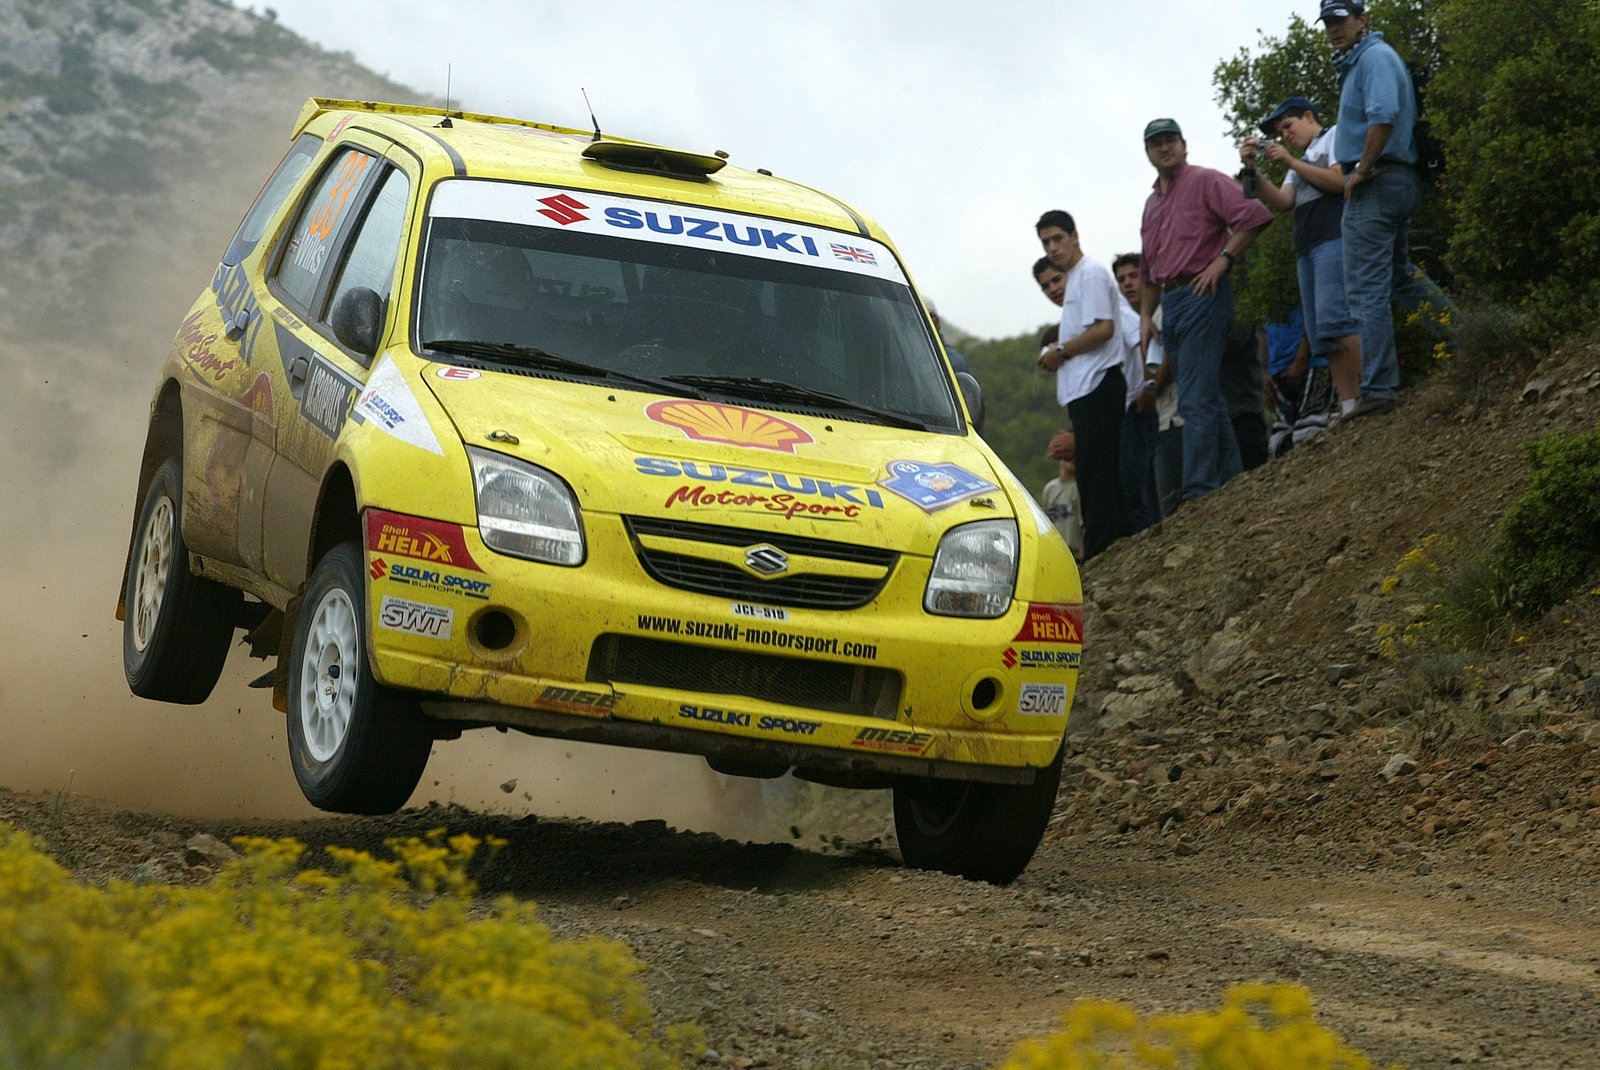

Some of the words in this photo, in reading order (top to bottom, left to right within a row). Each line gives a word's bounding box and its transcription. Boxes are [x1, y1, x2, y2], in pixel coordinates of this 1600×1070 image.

[603, 206, 820, 257] SUZUKI
[443, 367, 475, 379] E
[634, 456, 884, 509] SUZUKI
[381, 524, 409, 537] Shell
[378, 531, 452, 563] HELIX
[390, 563, 440, 584] SUZUKI
[441, 574, 492, 593] SPORT
[410, 580, 464, 596] EUROPE
[382, 604, 449, 635] SWT
[1032, 616, 1080, 641] HELIX
[637, 614, 878, 660] www.suzuki-motorsport.com
[1019, 689, 1065, 713] SWT
[679, 703, 751, 728] SUZUKI
[756, 718, 823, 736] SPORT
